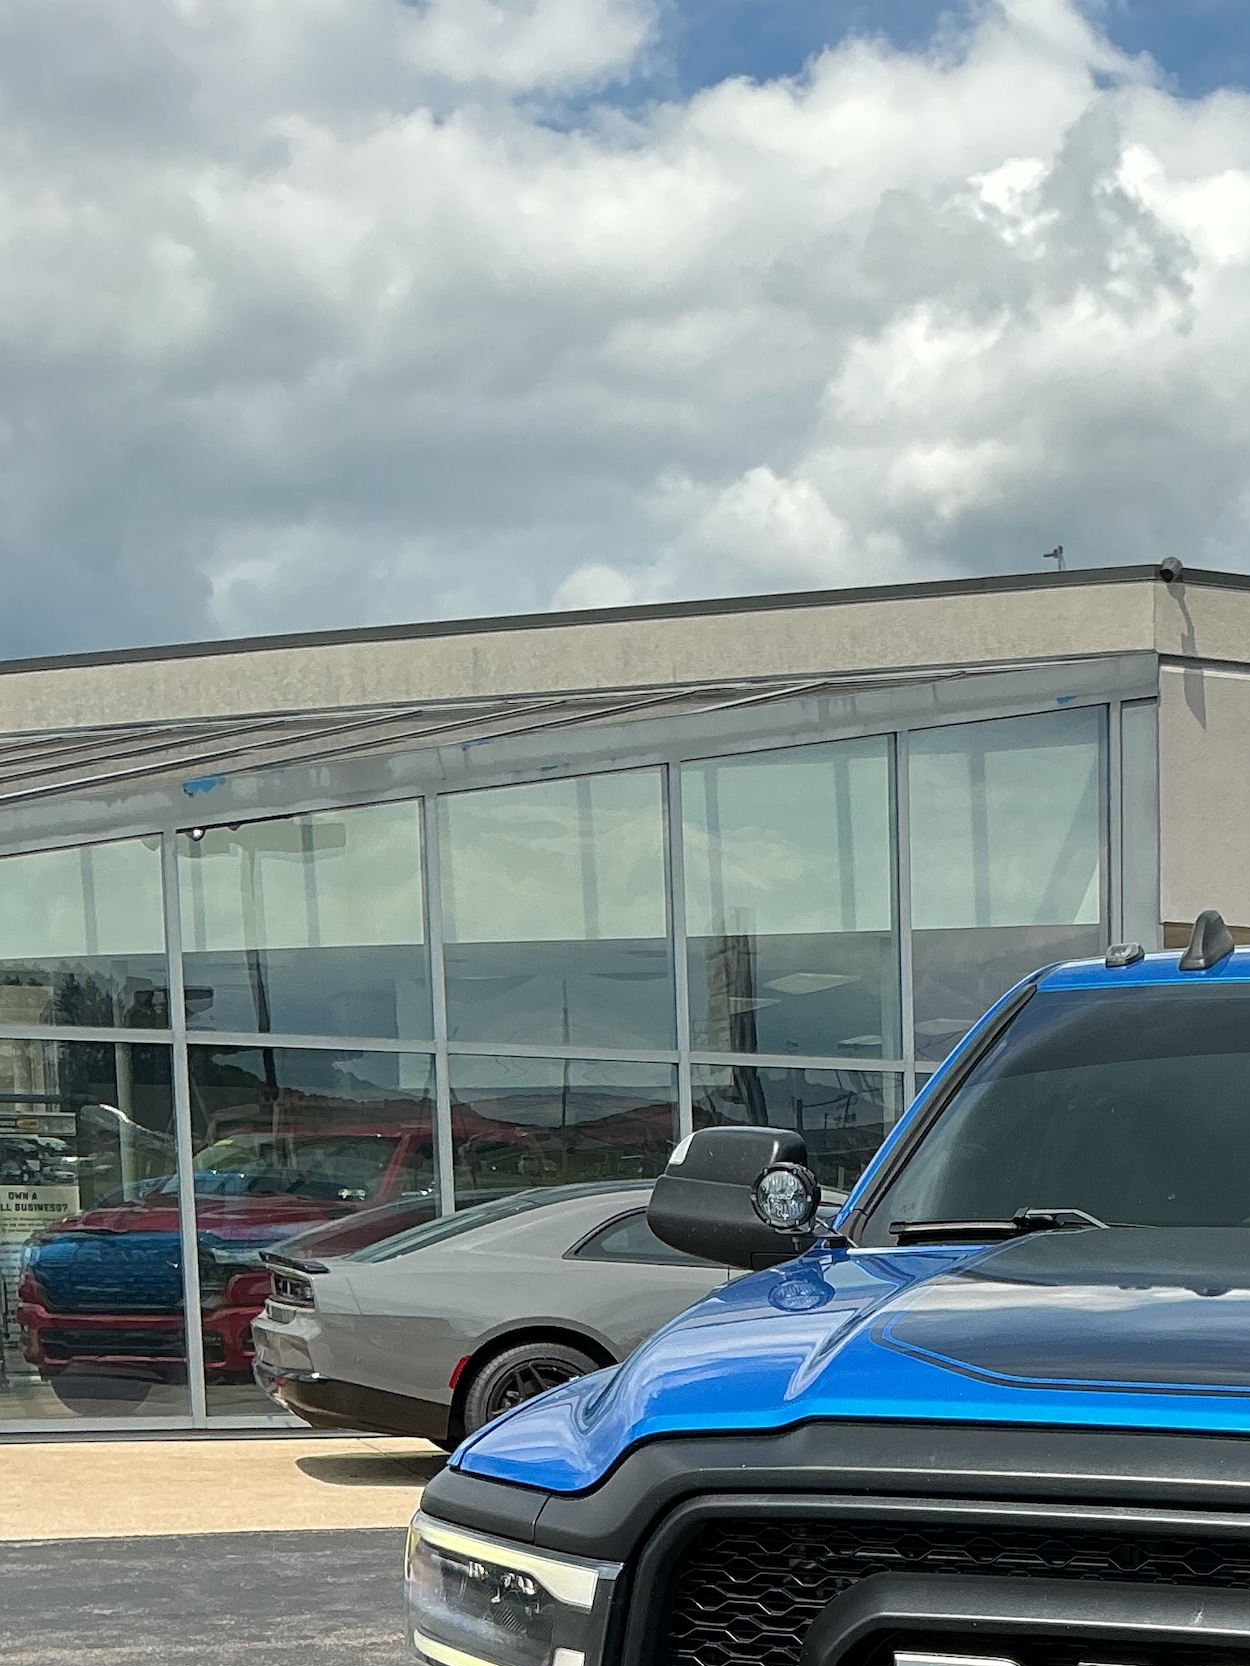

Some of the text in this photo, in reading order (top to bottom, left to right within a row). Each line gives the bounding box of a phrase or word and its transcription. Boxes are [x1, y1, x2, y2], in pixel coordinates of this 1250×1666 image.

[8, 1191, 38, 1201] OWN A
[15, 1203, 68, 1212] BUSINESS?
